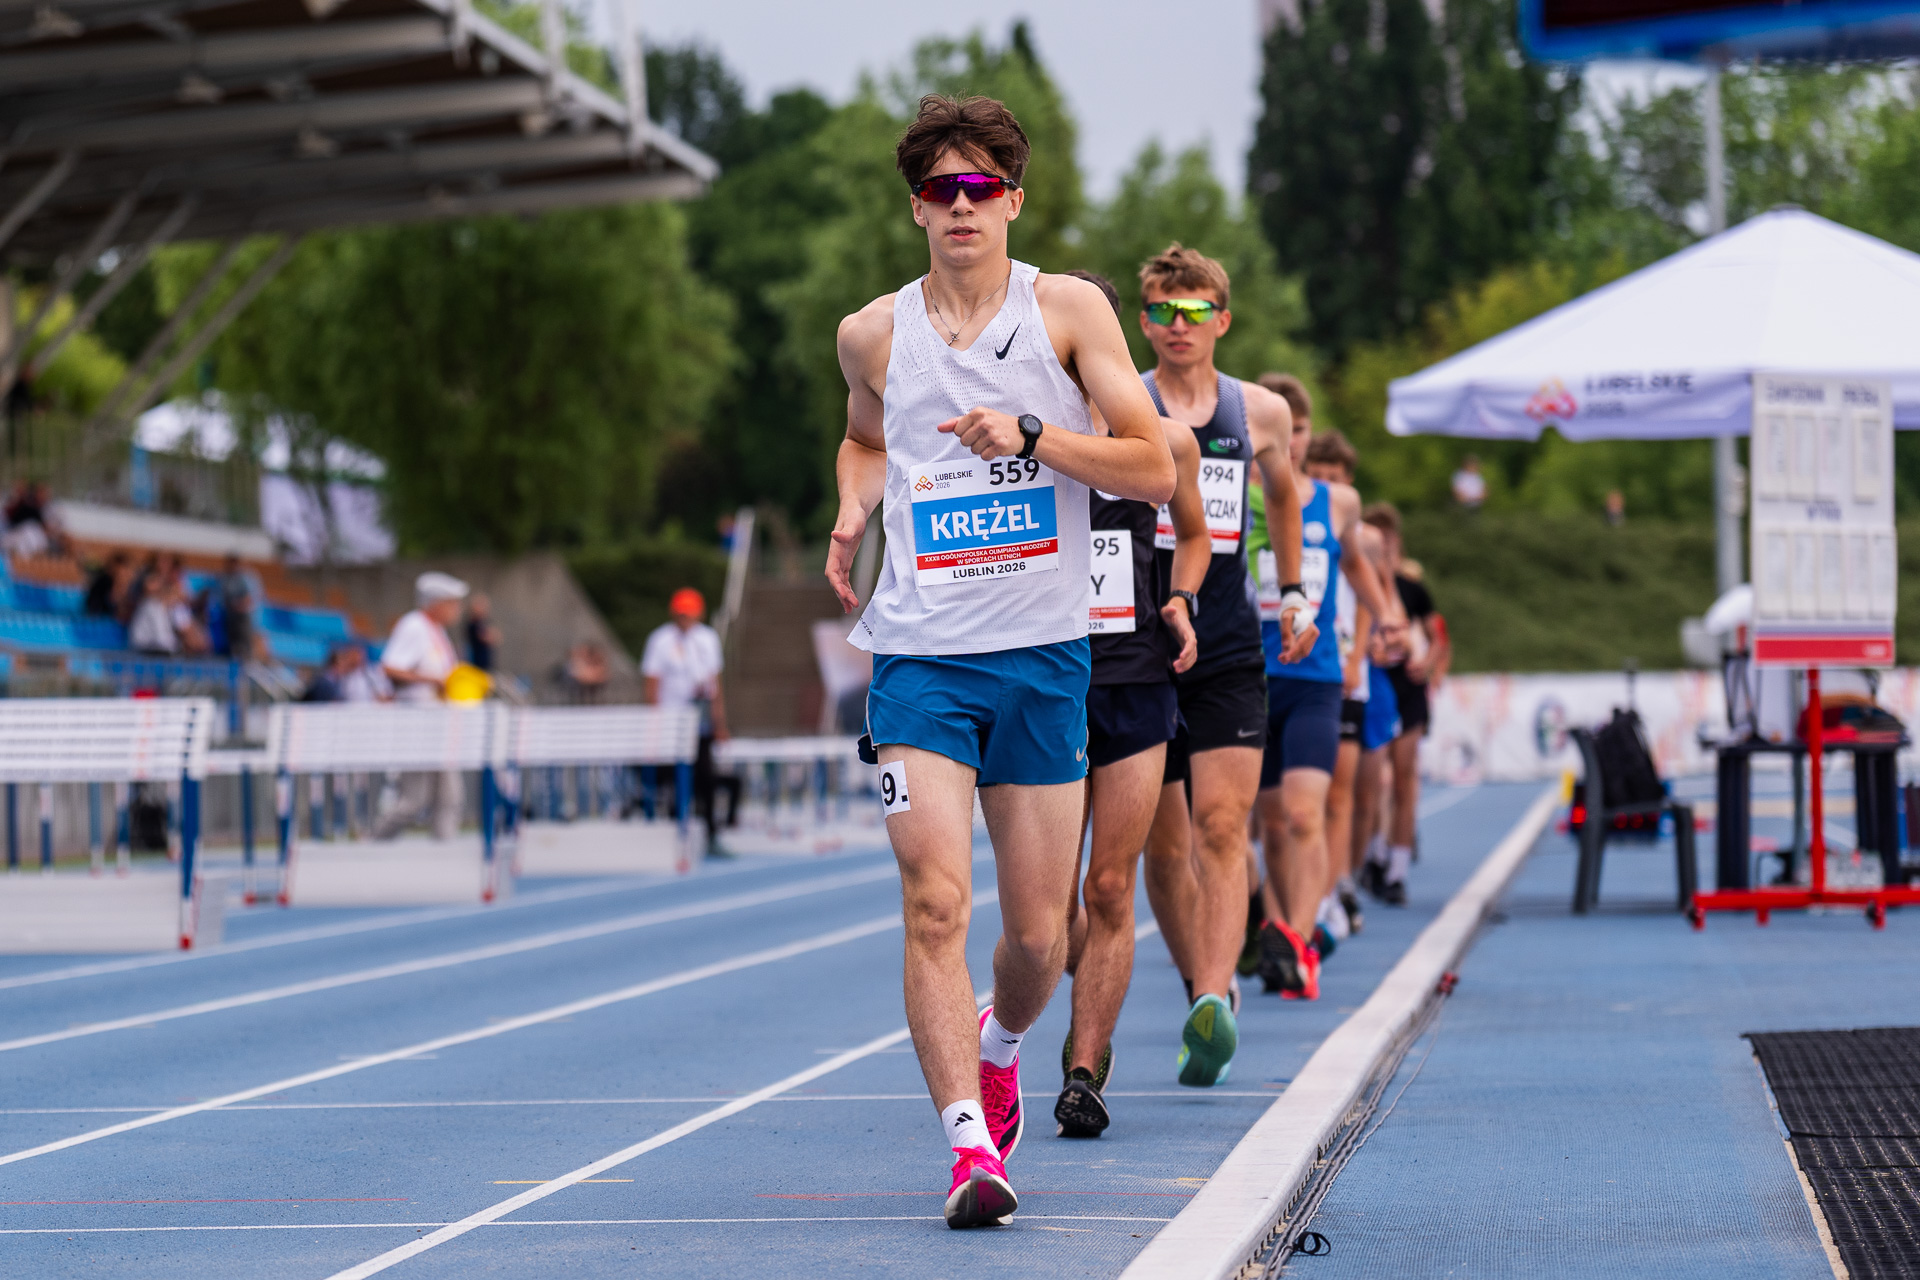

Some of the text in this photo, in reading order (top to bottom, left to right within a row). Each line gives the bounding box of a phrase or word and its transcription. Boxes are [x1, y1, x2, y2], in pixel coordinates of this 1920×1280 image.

[934, 469, 974, 482] LUBELSKIE
[989, 459, 1040, 486] 559
[1203, 465, 1234, 484] 994
[935, 481, 951, 490] 2026
[930, 499, 1041, 542] KRĘŻEL
[924, 541, 1051, 563] XXXII OGÓLNOPOLSKA OLIMPIADA MŁODZIEŻY
[964, 555, 997, 565] SPORTACH
[997, 552, 1022, 561] LETNICH
[953, 561, 1026, 579] LUBLIN 2026
[882, 771, 909, 807] 9.
